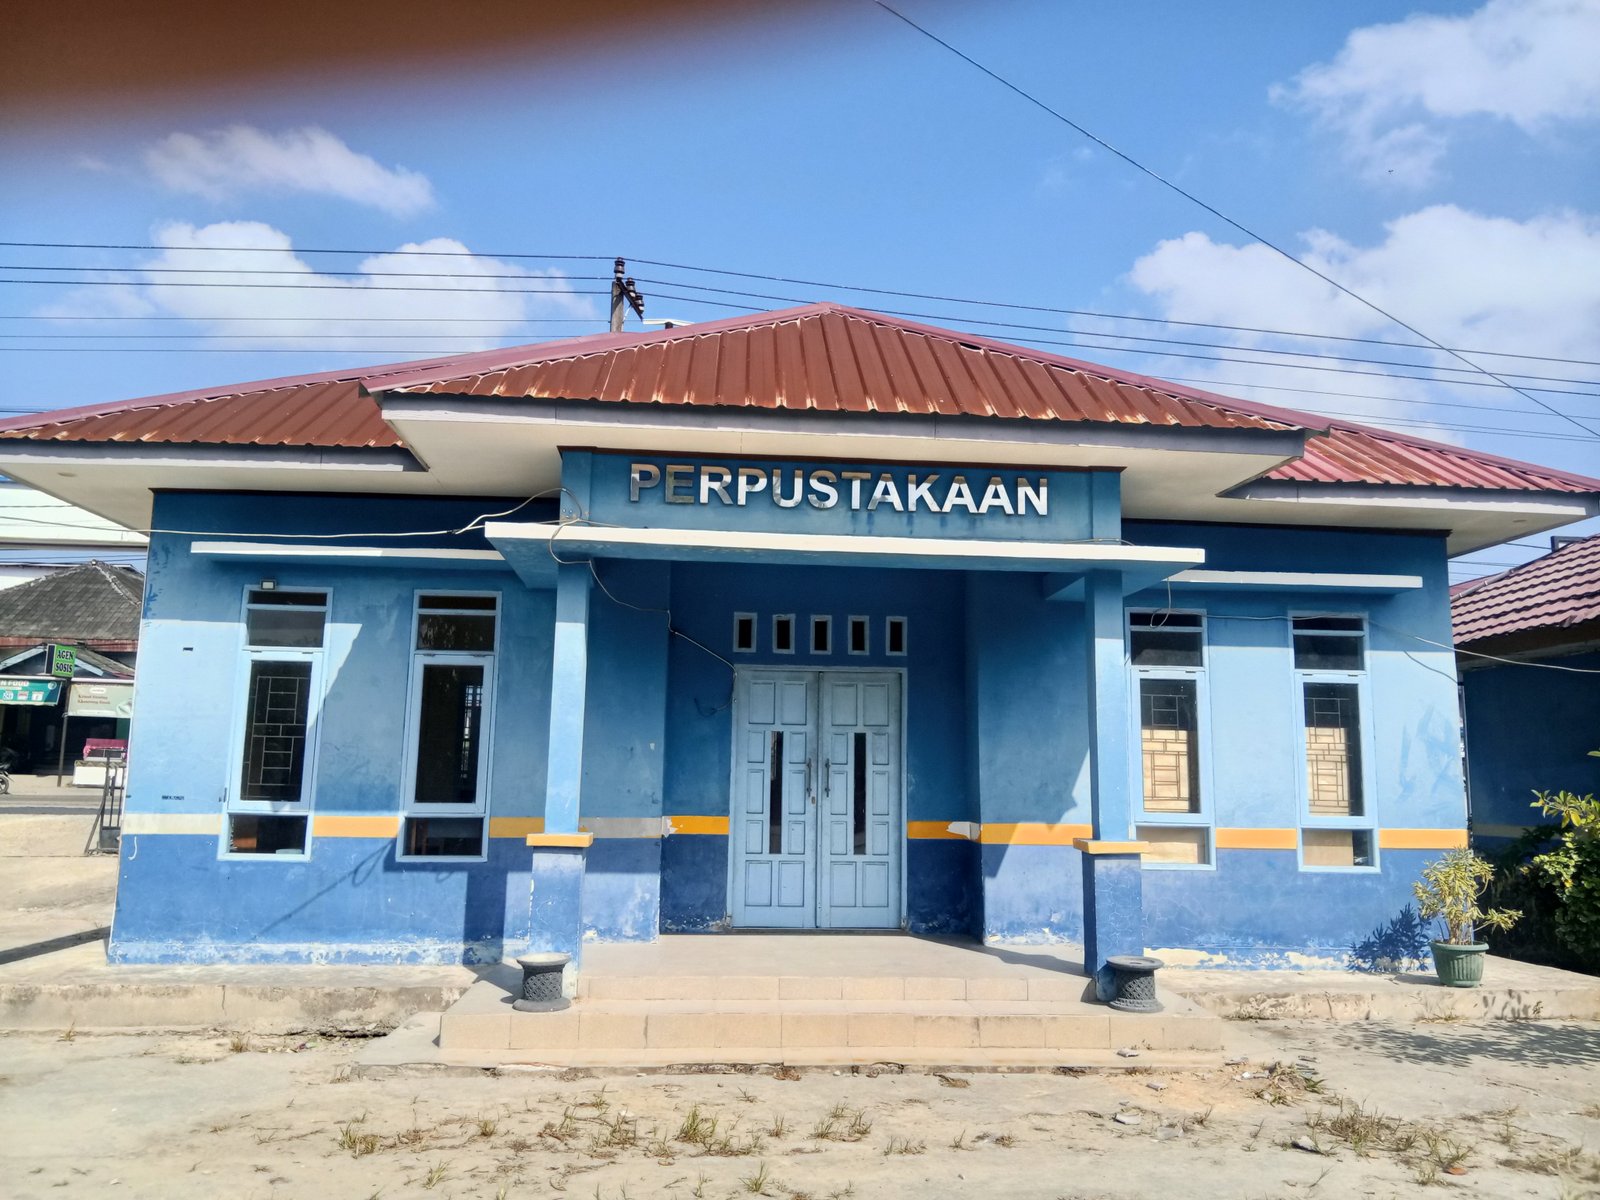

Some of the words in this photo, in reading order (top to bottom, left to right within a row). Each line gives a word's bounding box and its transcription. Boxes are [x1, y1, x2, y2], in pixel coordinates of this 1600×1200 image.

[630, 463, 1048, 516] PERPUSTAKAAN
[57, 650, 74, 660] AGEN
[55, 662, 73, 673] SOSIS
